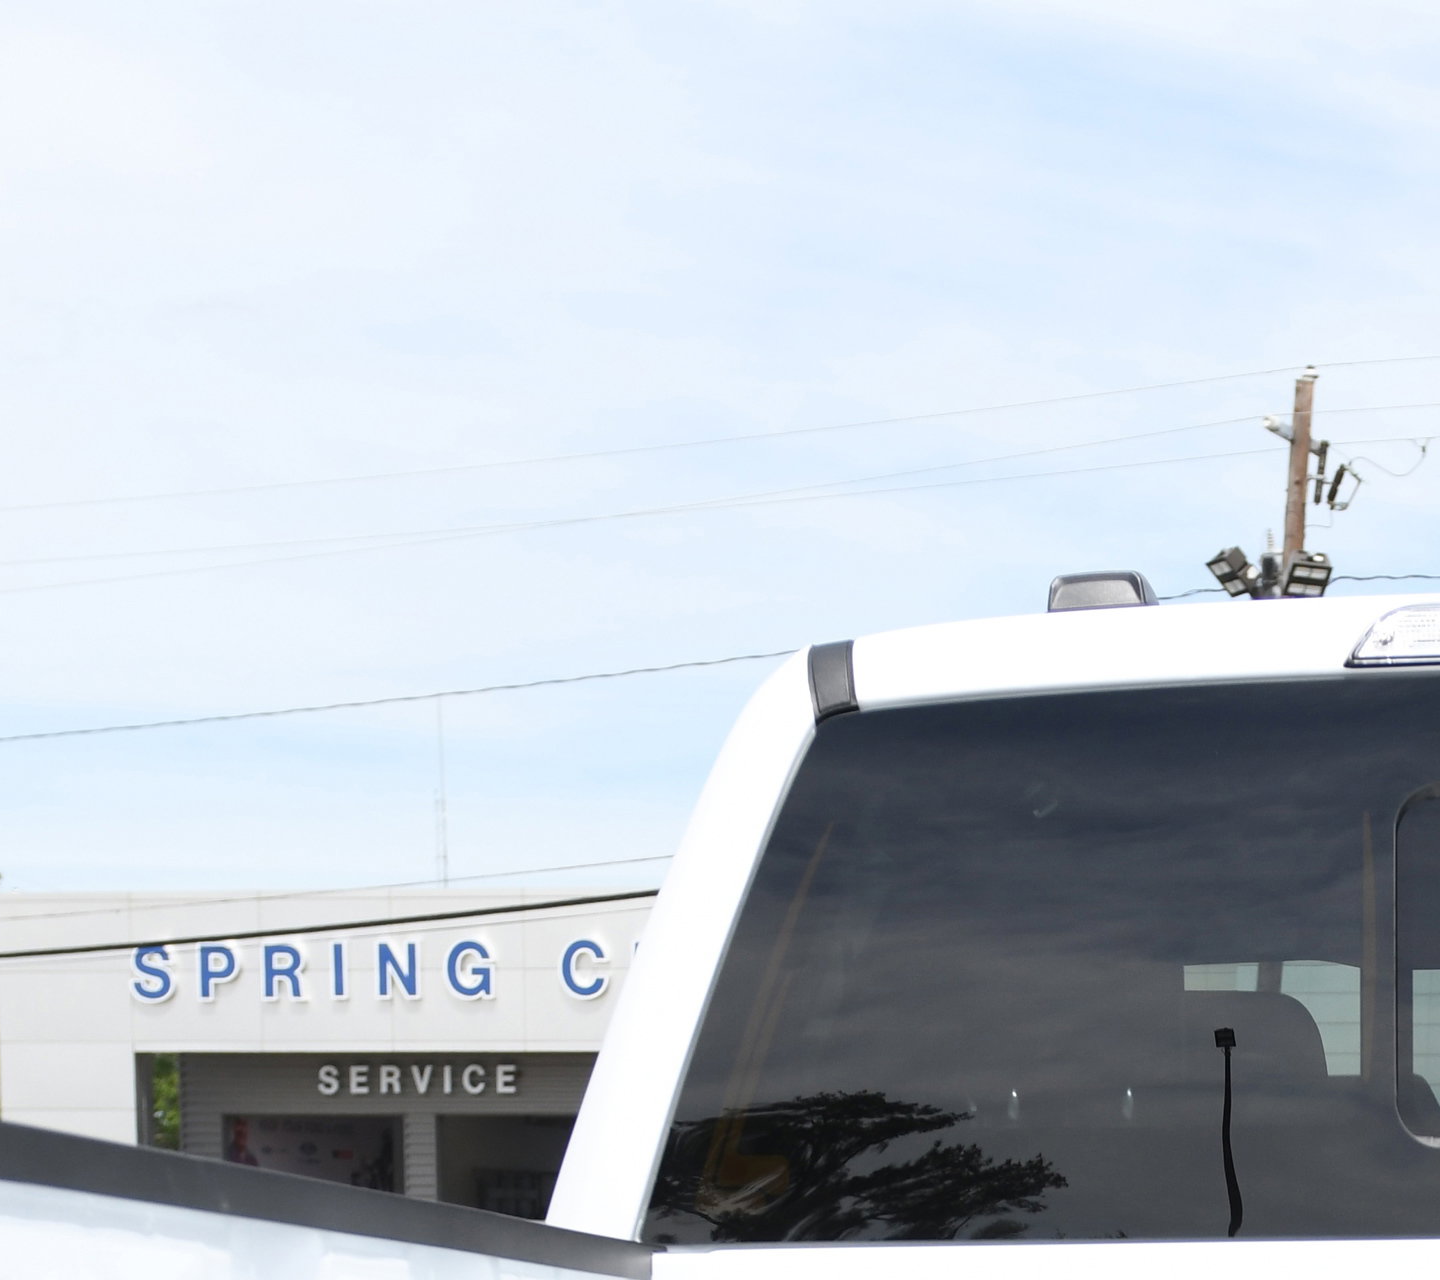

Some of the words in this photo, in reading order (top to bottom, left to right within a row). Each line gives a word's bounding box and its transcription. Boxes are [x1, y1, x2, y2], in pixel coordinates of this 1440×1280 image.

[134, 941, 491, 997] SPRING
[562, 940, 639, 996] C
[318, 1065, 517, 1095] SERVICE
